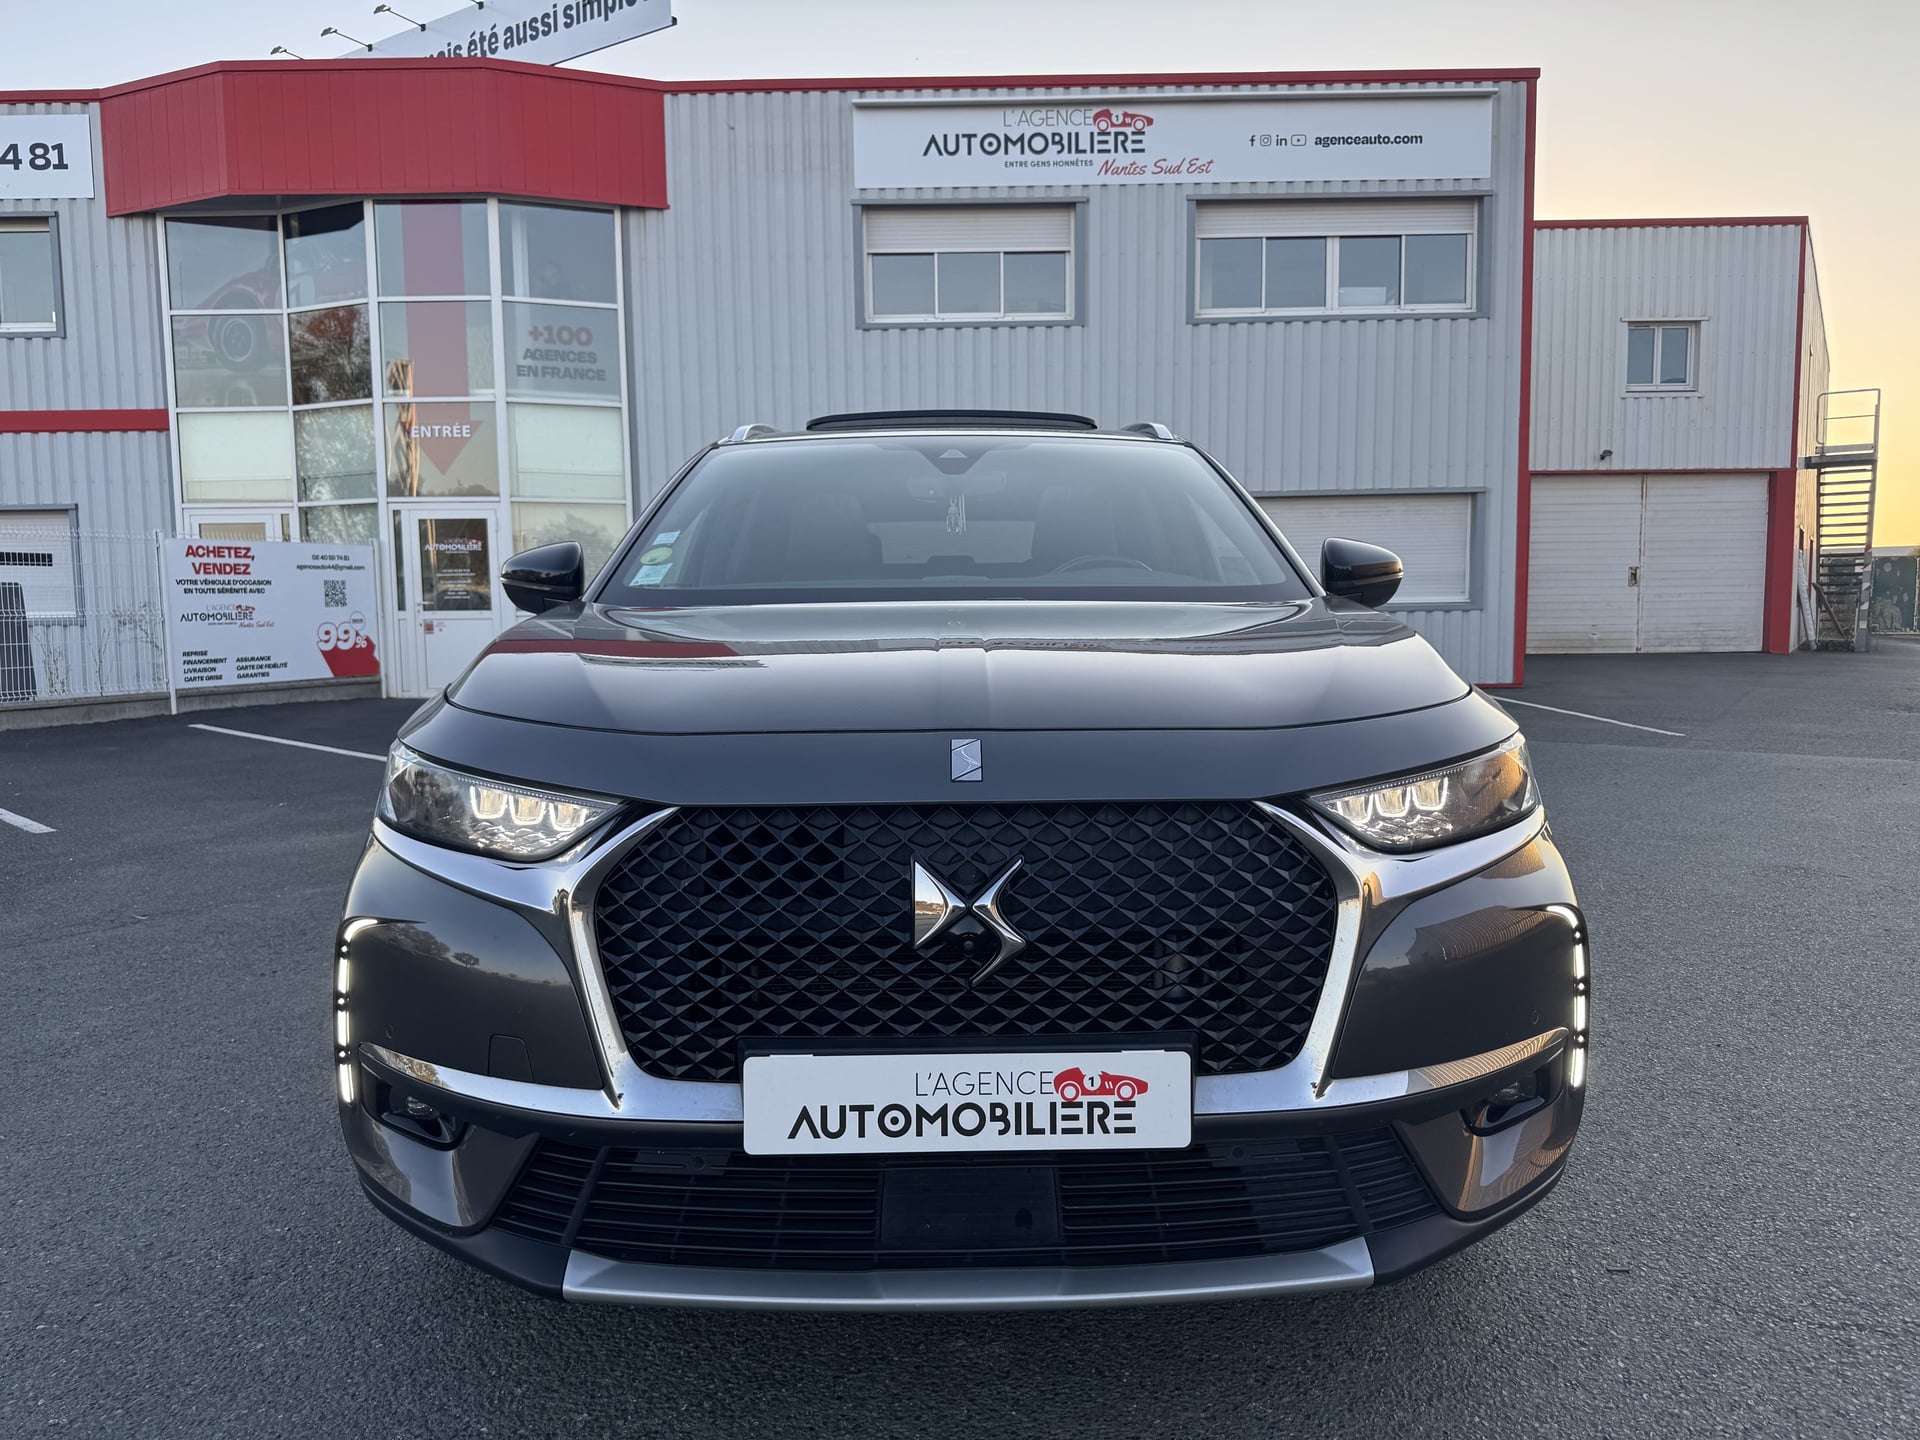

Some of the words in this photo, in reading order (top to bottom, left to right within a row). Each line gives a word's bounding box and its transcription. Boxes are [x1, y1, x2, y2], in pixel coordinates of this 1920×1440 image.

[467, 22, 499, 58] été
[503, 2, 558, 51] aussi
[563, 0, 637, 29] simp
[1003, 108, 1094, 127] L'AGENCE
[1314, 134, 1423, 148] agenceauto.com
[28, 142, 68, 170] 81
[1030, 160, 1052, 168] GENS
[1052, 158, 1094, 168] HONNÊTES
[1097, 158, 1147, 176] Nantes
[1151, 157, 1186, 176] Sud
[1186, 157, 1215, 174] Est
[528, 324, 593, 347] +100
[522, 348, 598, 364] AGENCES
[516, 364, 539, 378] EN
[541, 366, 607, 382] FRANCE
[411, 422, 471, 438] ENTRÉE
[185, 545, 255, 561] ACHETEZ,
[192, 562, 252, 575] VENDEZ
[200, 578, 231, 586] VÉHICULE
[183, 657, 227, 665] FINANCEMENT
[915, 1070, 1054, 1098] L'AGENCE
